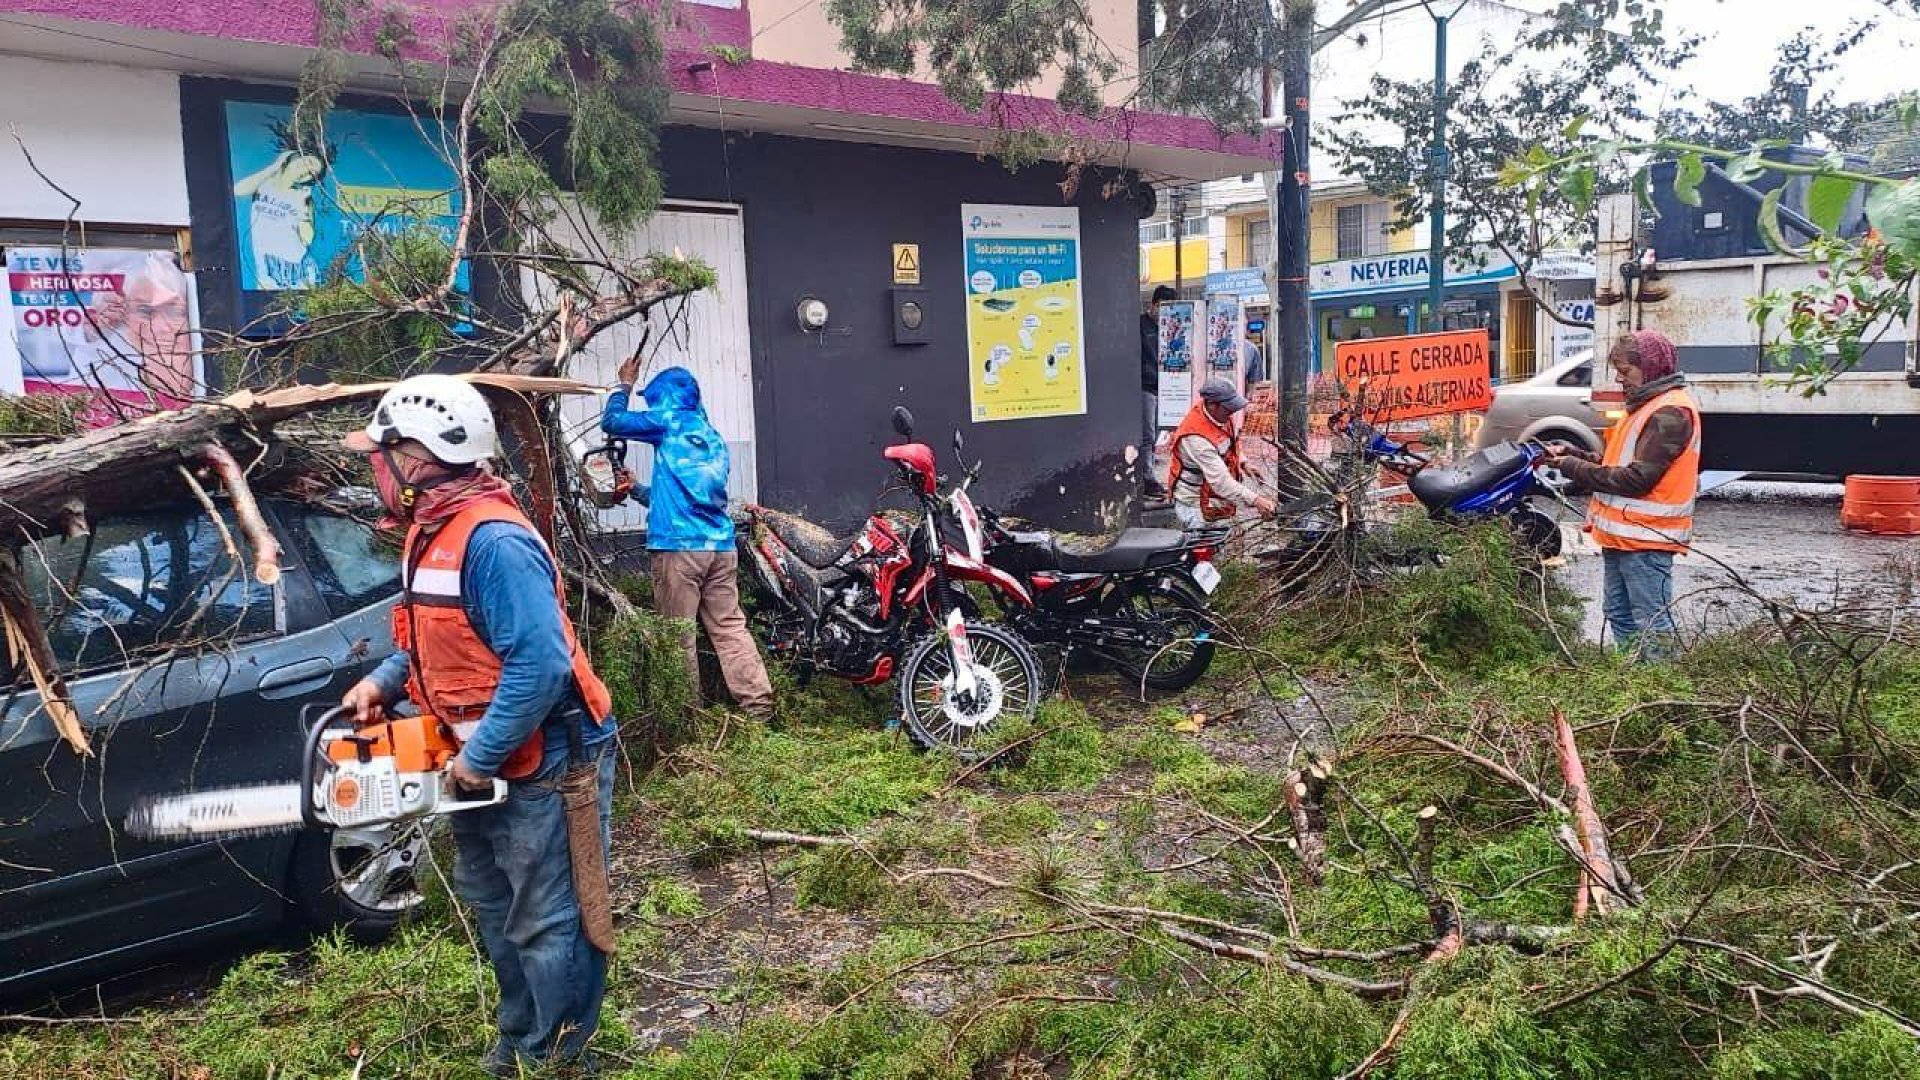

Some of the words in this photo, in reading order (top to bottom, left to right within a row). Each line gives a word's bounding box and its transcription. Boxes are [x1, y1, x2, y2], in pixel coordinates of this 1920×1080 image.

[16, 257, 39, 271] TE
[1351, 256, 1429, 282] NEVERIA
[30, 276, 114, 291] HERMOSA
[1345, 350, 1400, 378] CALLE
[1410, 342, 1483, 372] CERRADA
[1416, 377, 1484, 406] ALTERNAS
